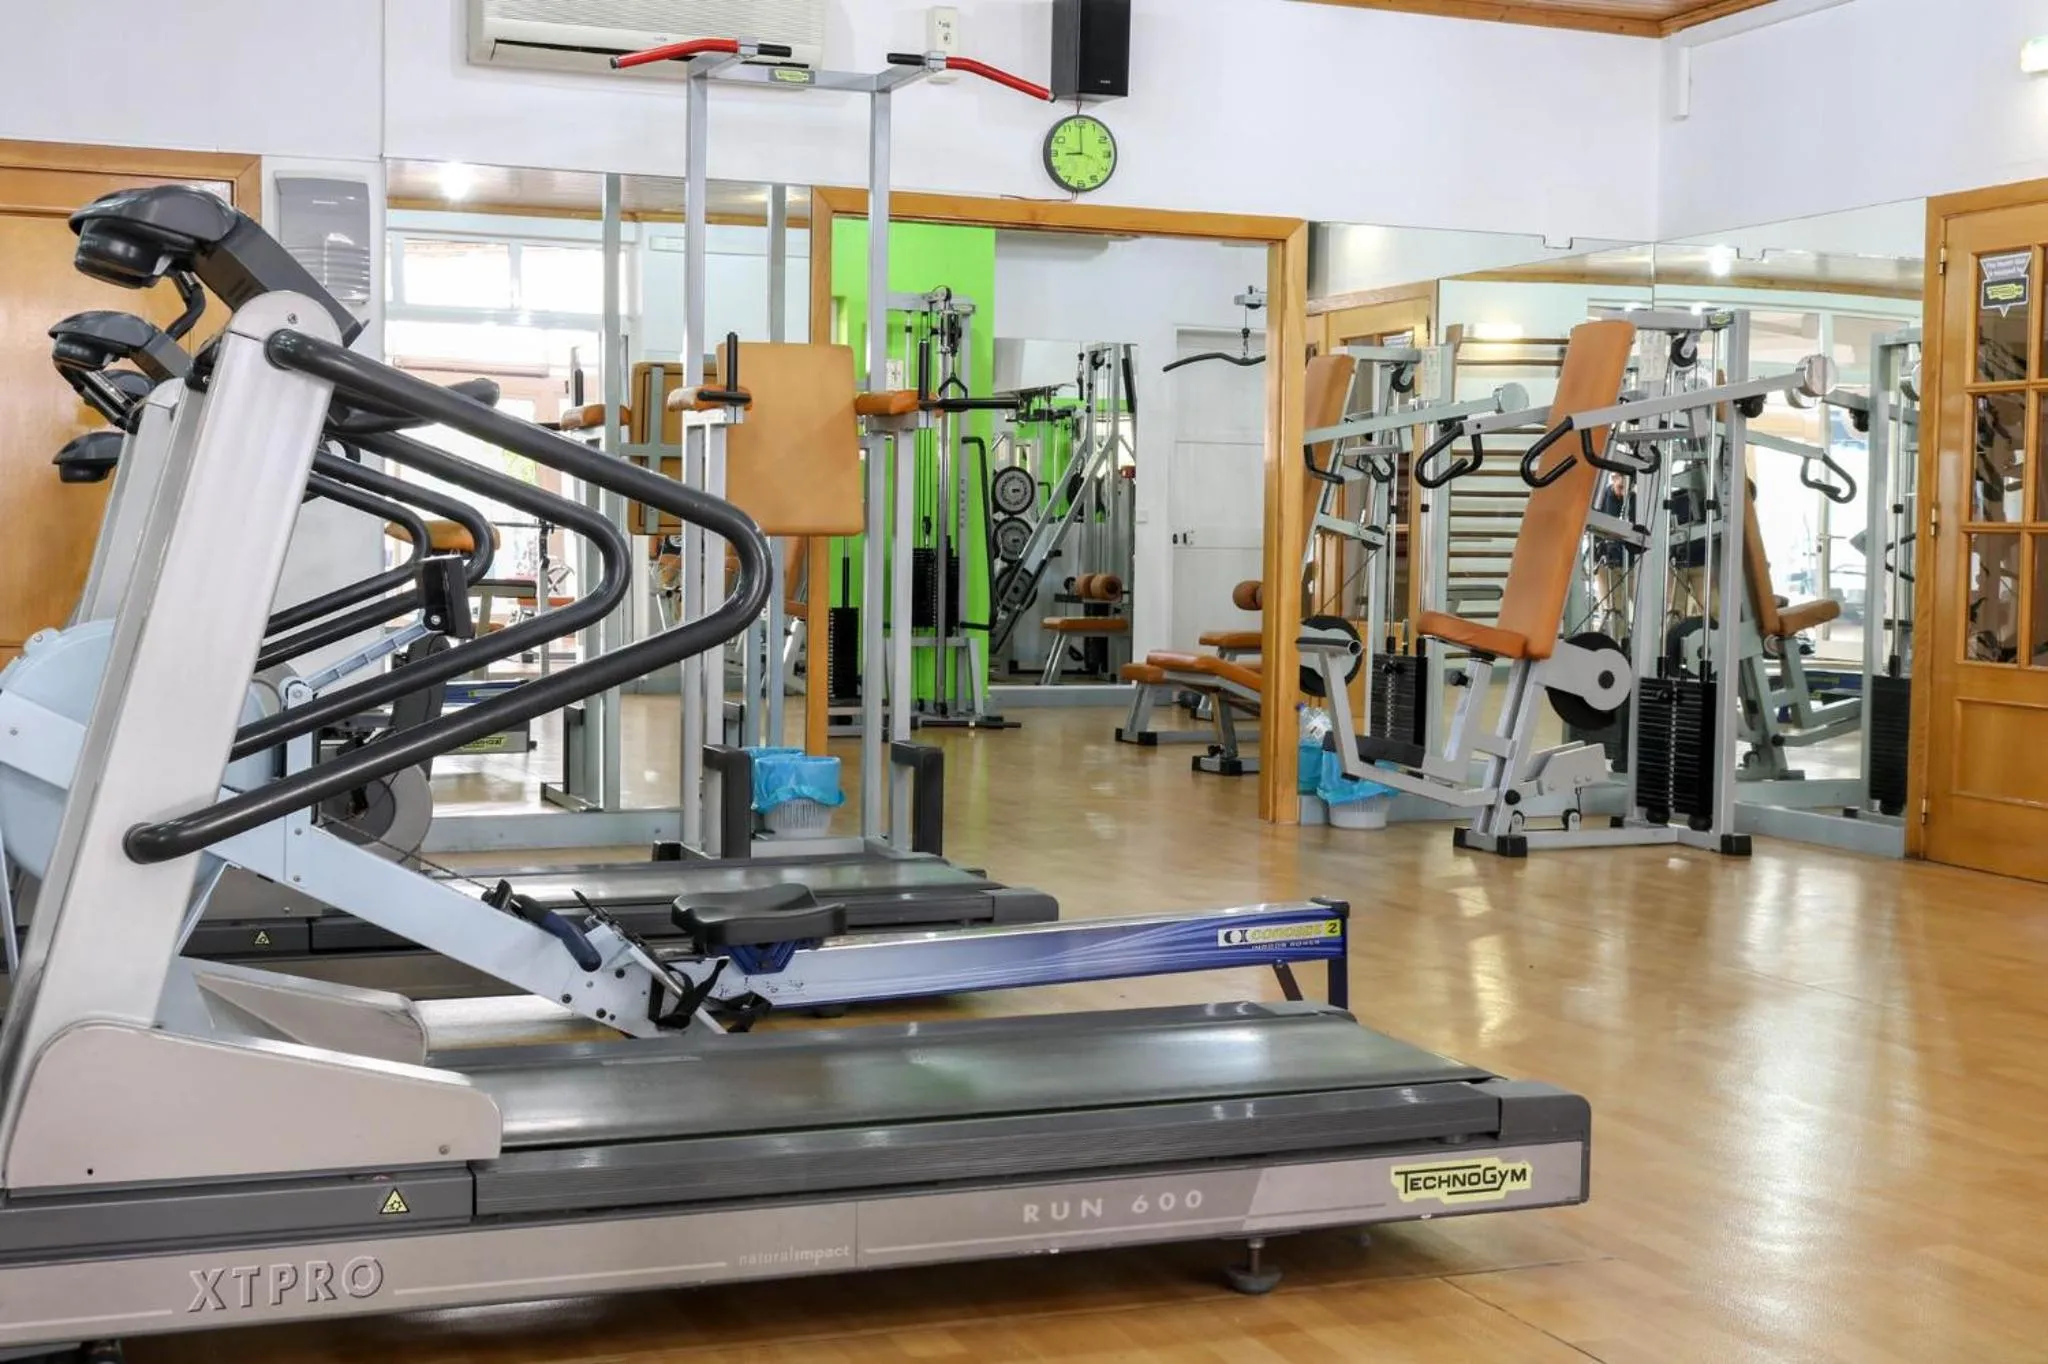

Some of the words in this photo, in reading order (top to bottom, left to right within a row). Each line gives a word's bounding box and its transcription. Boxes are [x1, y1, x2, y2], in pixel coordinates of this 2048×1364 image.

[1098, 135, 1108, 144] 2
[1327, 921, 1338, 935] 2
[1393, 1164, 1527, 1195] TECHNOGYM
[1022, 1198, 1103, 1224] RUN
[1131, 1189, 1202, 1214] 600
[187, 1256, 384, 1313] XTPRO
